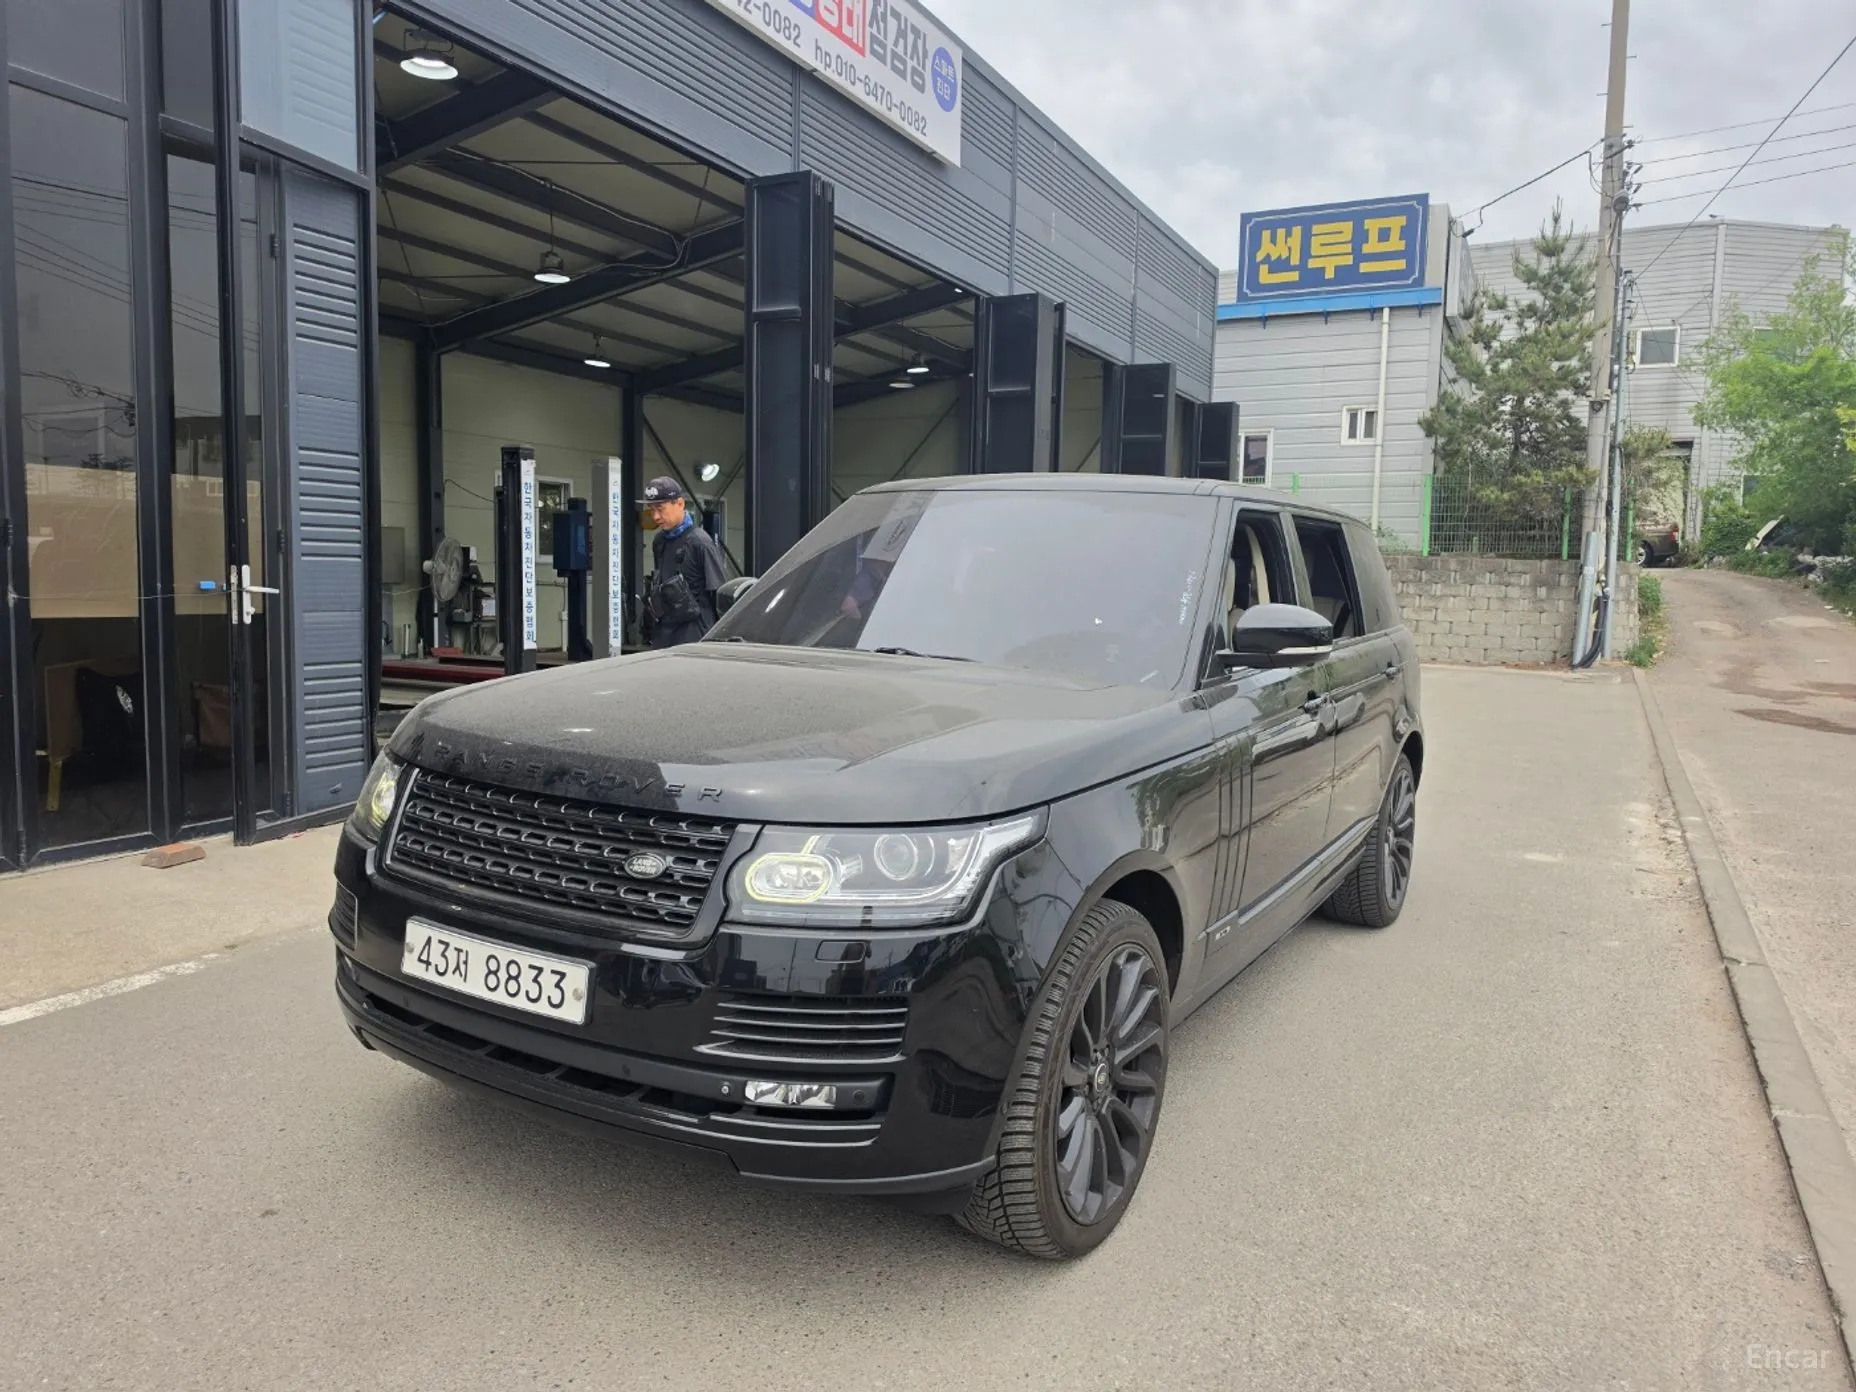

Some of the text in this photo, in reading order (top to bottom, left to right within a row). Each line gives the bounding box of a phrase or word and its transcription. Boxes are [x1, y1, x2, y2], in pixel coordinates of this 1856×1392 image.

[737, 0, 801, 48] 2-0082
[1255, 215, 1407, 285] 썬루프
[417, 935, 567, 1010] 43저 8833
